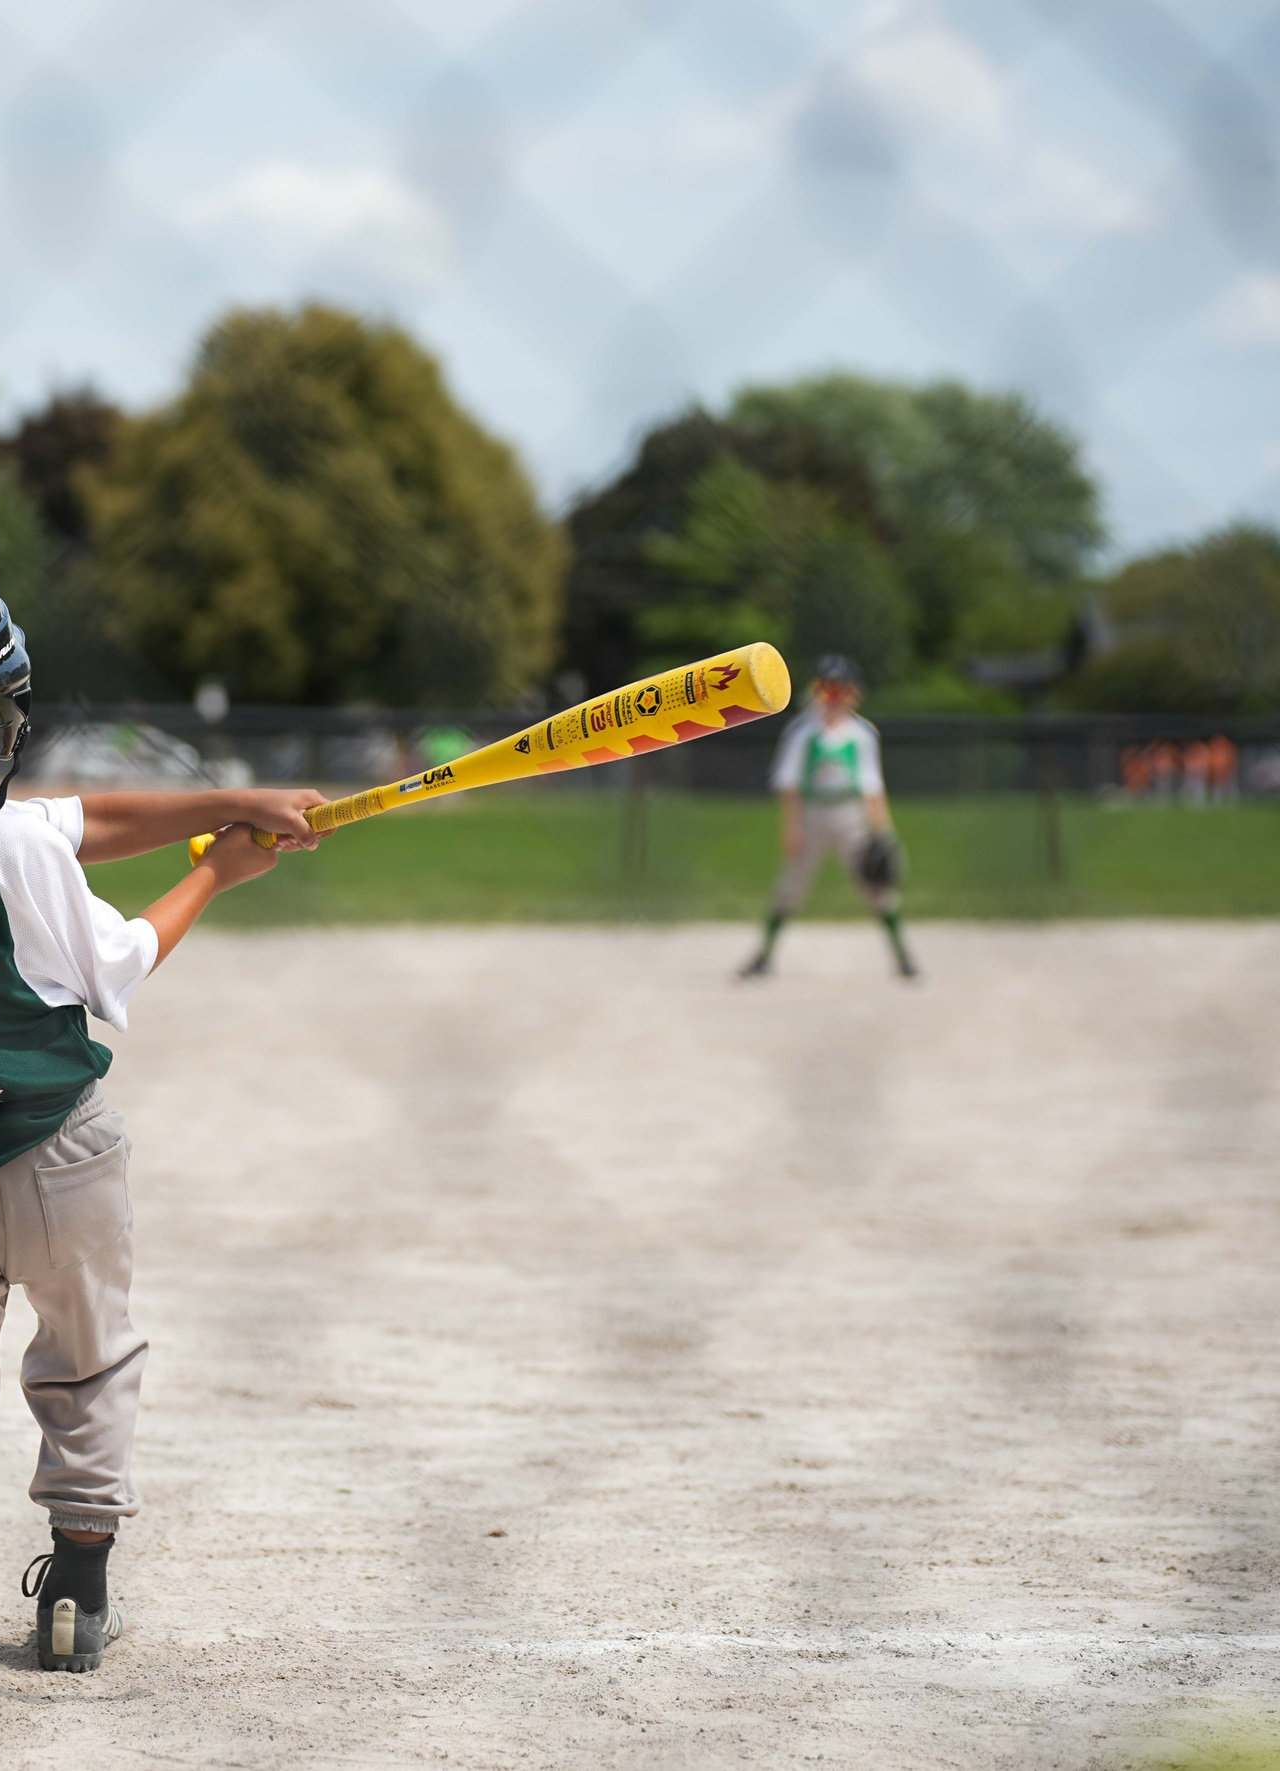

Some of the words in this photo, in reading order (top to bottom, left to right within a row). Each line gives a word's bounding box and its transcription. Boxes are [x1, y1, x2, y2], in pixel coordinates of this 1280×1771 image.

[686, 673, 694, 702] EASTON
[699, 667, 709, 700] HYPE
[590, 703, 607, 733] 13
[605, 701, 614, 728] DROP
[626, 691, 634, 724] LAUNCH
[570, 729, 578, 740] 13
[425, 778, 457, 791] BASEBALL
